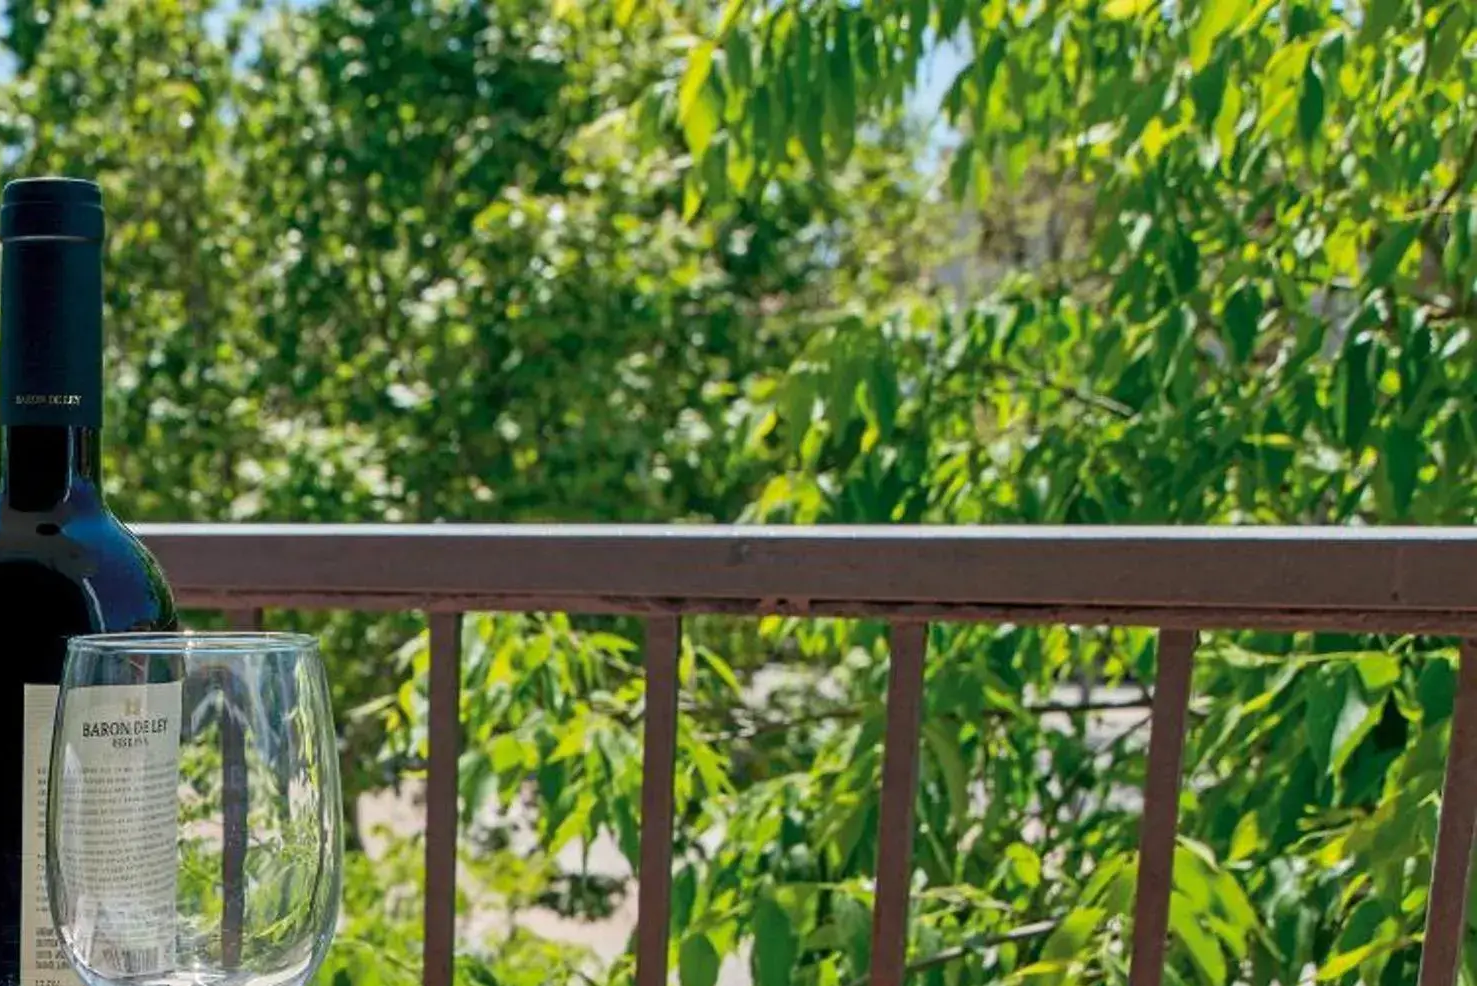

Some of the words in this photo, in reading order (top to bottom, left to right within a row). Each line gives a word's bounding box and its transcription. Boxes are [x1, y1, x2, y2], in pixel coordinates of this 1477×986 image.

[82, 722, 131, 738] BARON
[134, 720, 149, 735] DE
[151, 717, 169, 733] LEY
